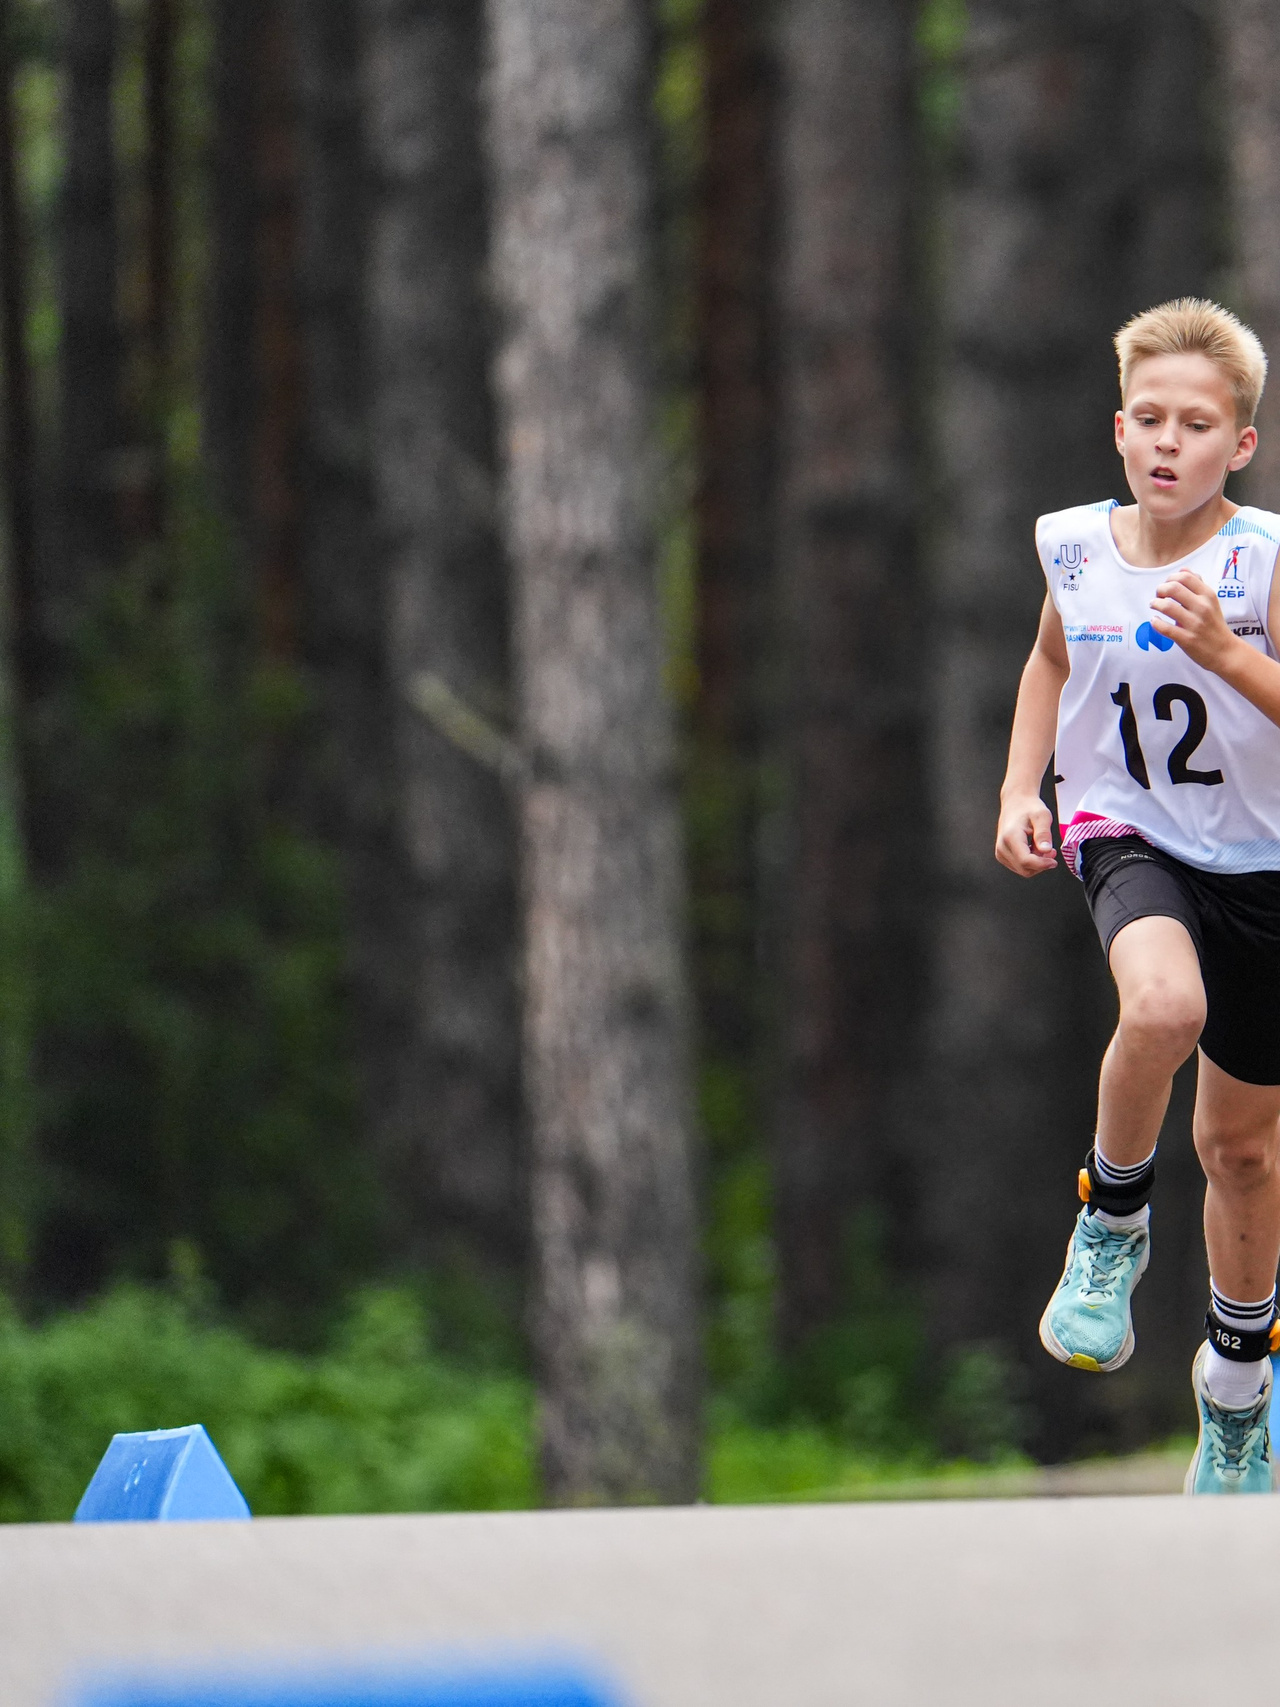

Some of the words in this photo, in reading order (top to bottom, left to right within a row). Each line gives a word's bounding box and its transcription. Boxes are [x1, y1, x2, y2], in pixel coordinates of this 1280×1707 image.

[1063, 583, 1079, 591] FISU
[1217, 590, 1245, 598] СБР
[1107, 635, 1123, 643] 2019
[1110, 682, 1224, 790] 12
[1216, 1328, 1241, 1350] 162
